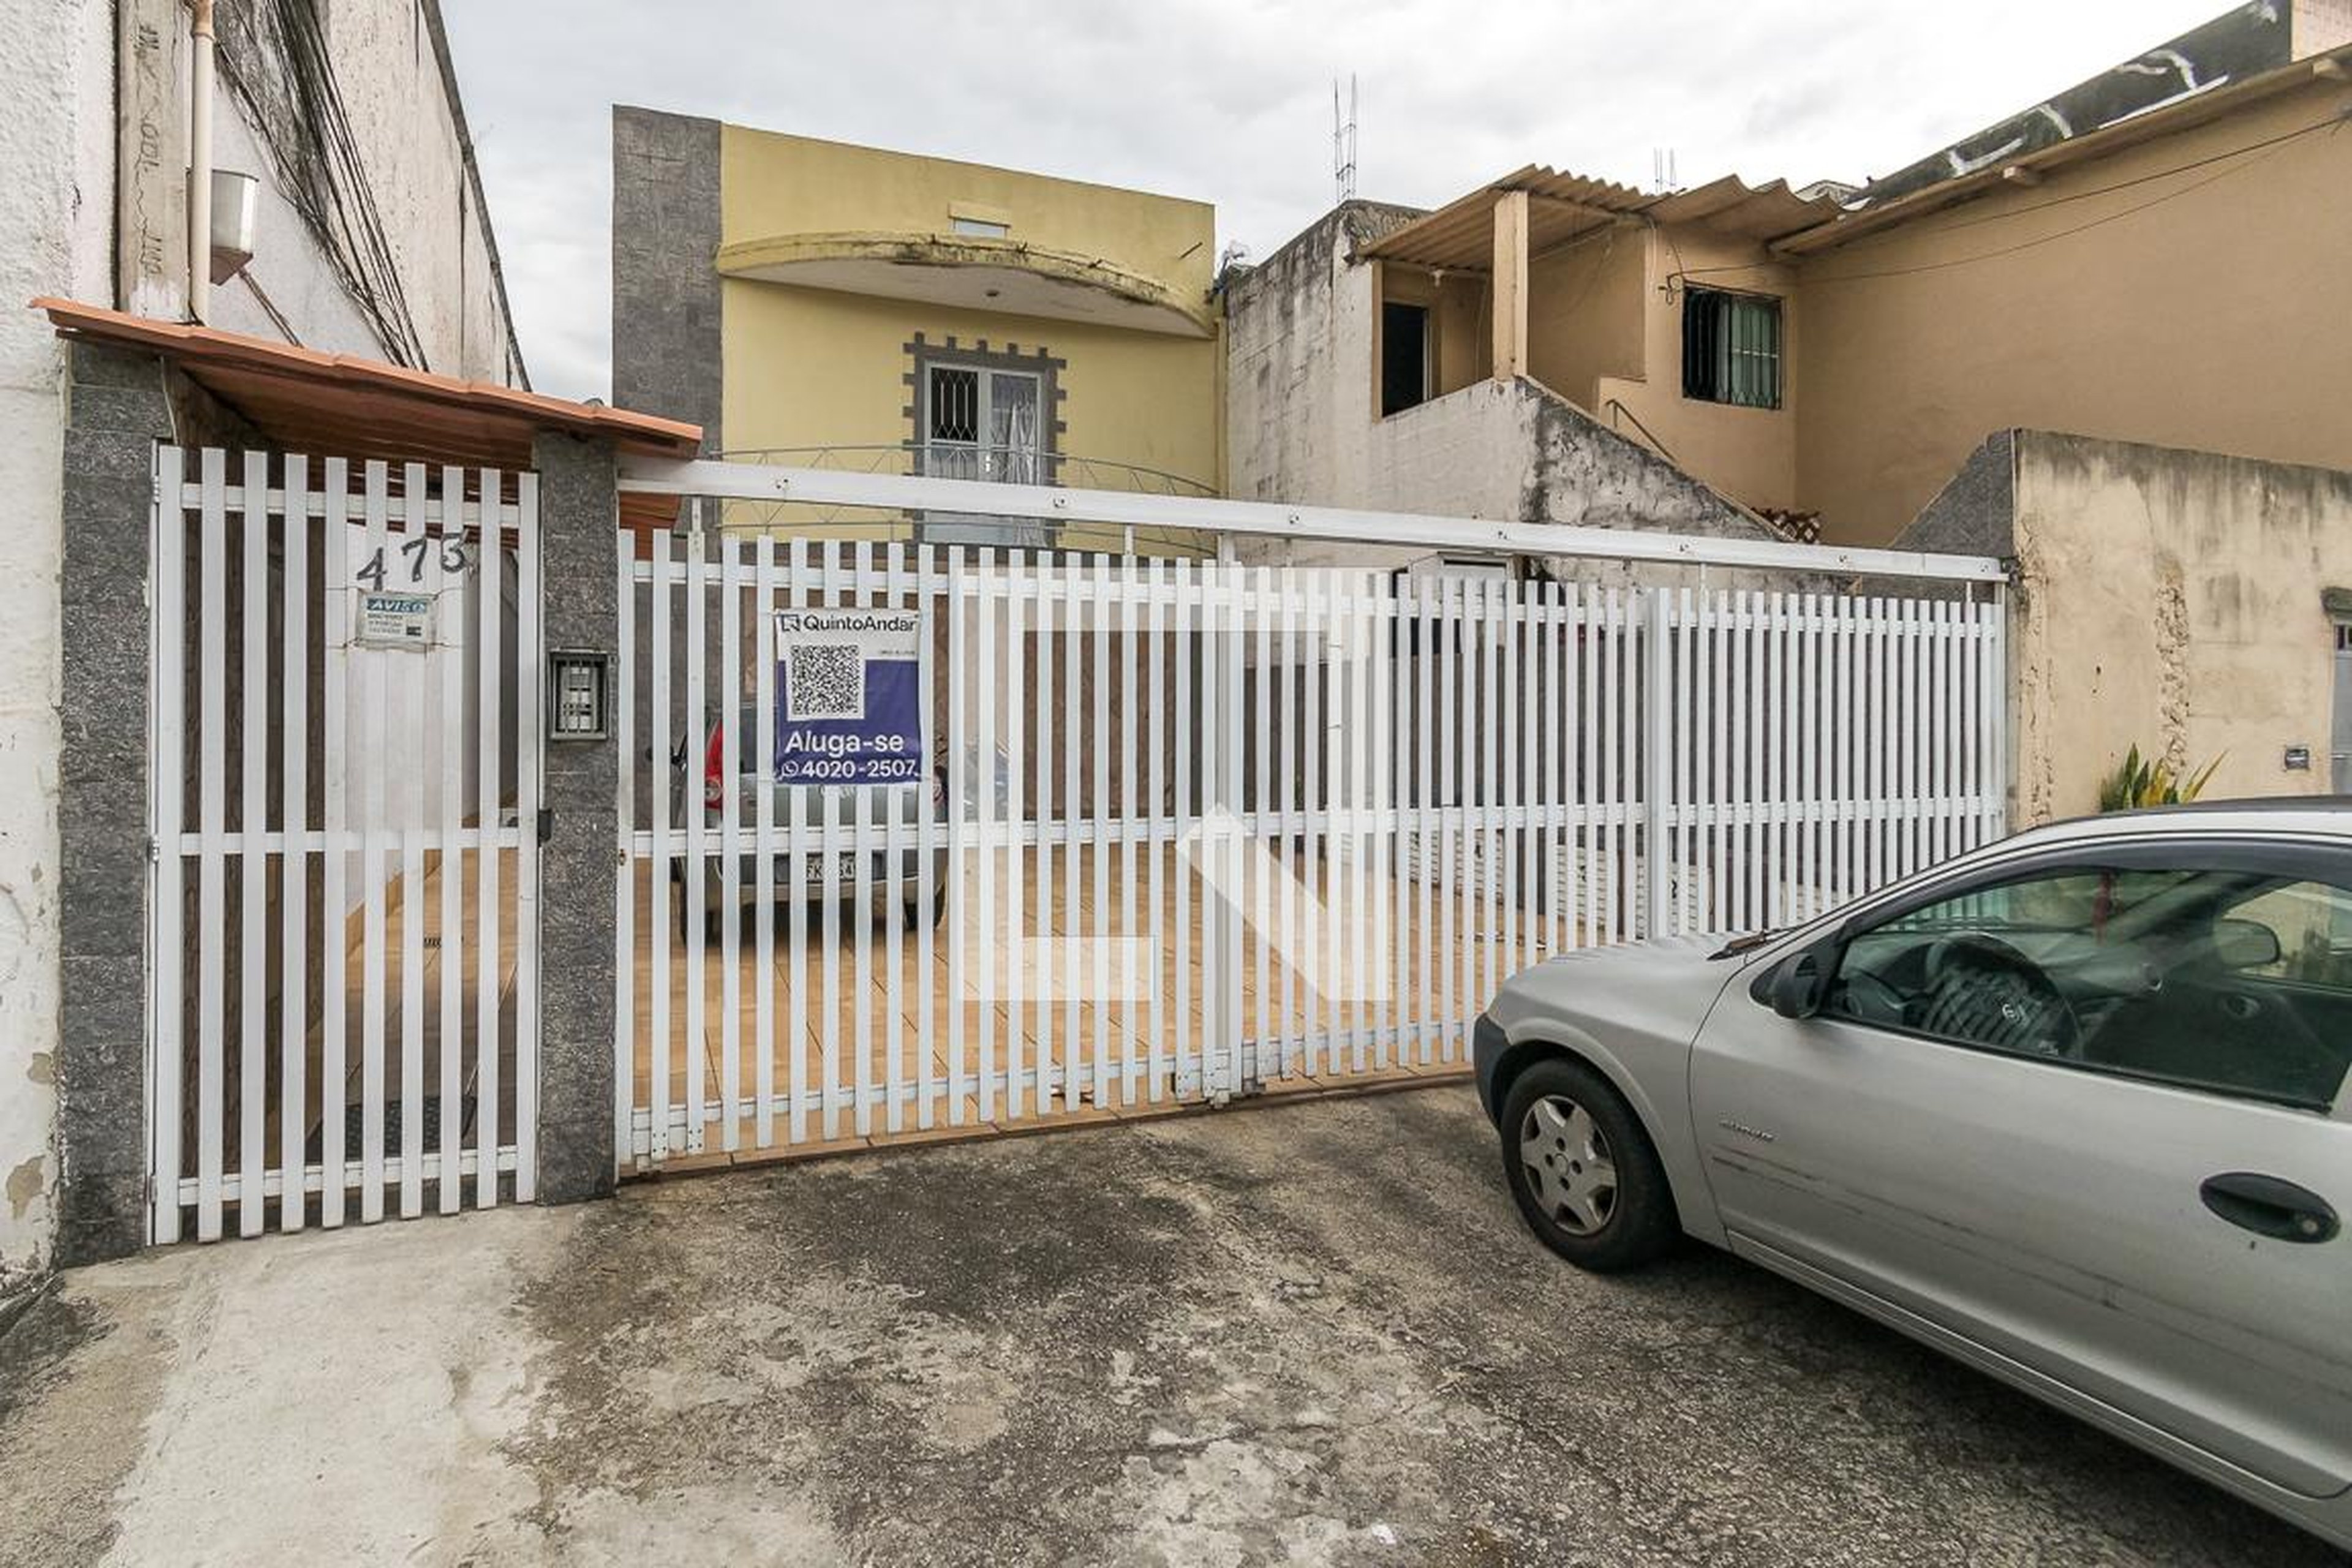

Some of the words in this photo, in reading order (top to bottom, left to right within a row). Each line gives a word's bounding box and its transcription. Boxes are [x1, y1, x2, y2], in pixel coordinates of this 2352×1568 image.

[371, 600, 426, 613] AVISO
[804, 614, 916, 632] QuintoAndar
[784, 730, 905, 758] Aluga-se
[801, 759, 916, 778] 4020-2507
